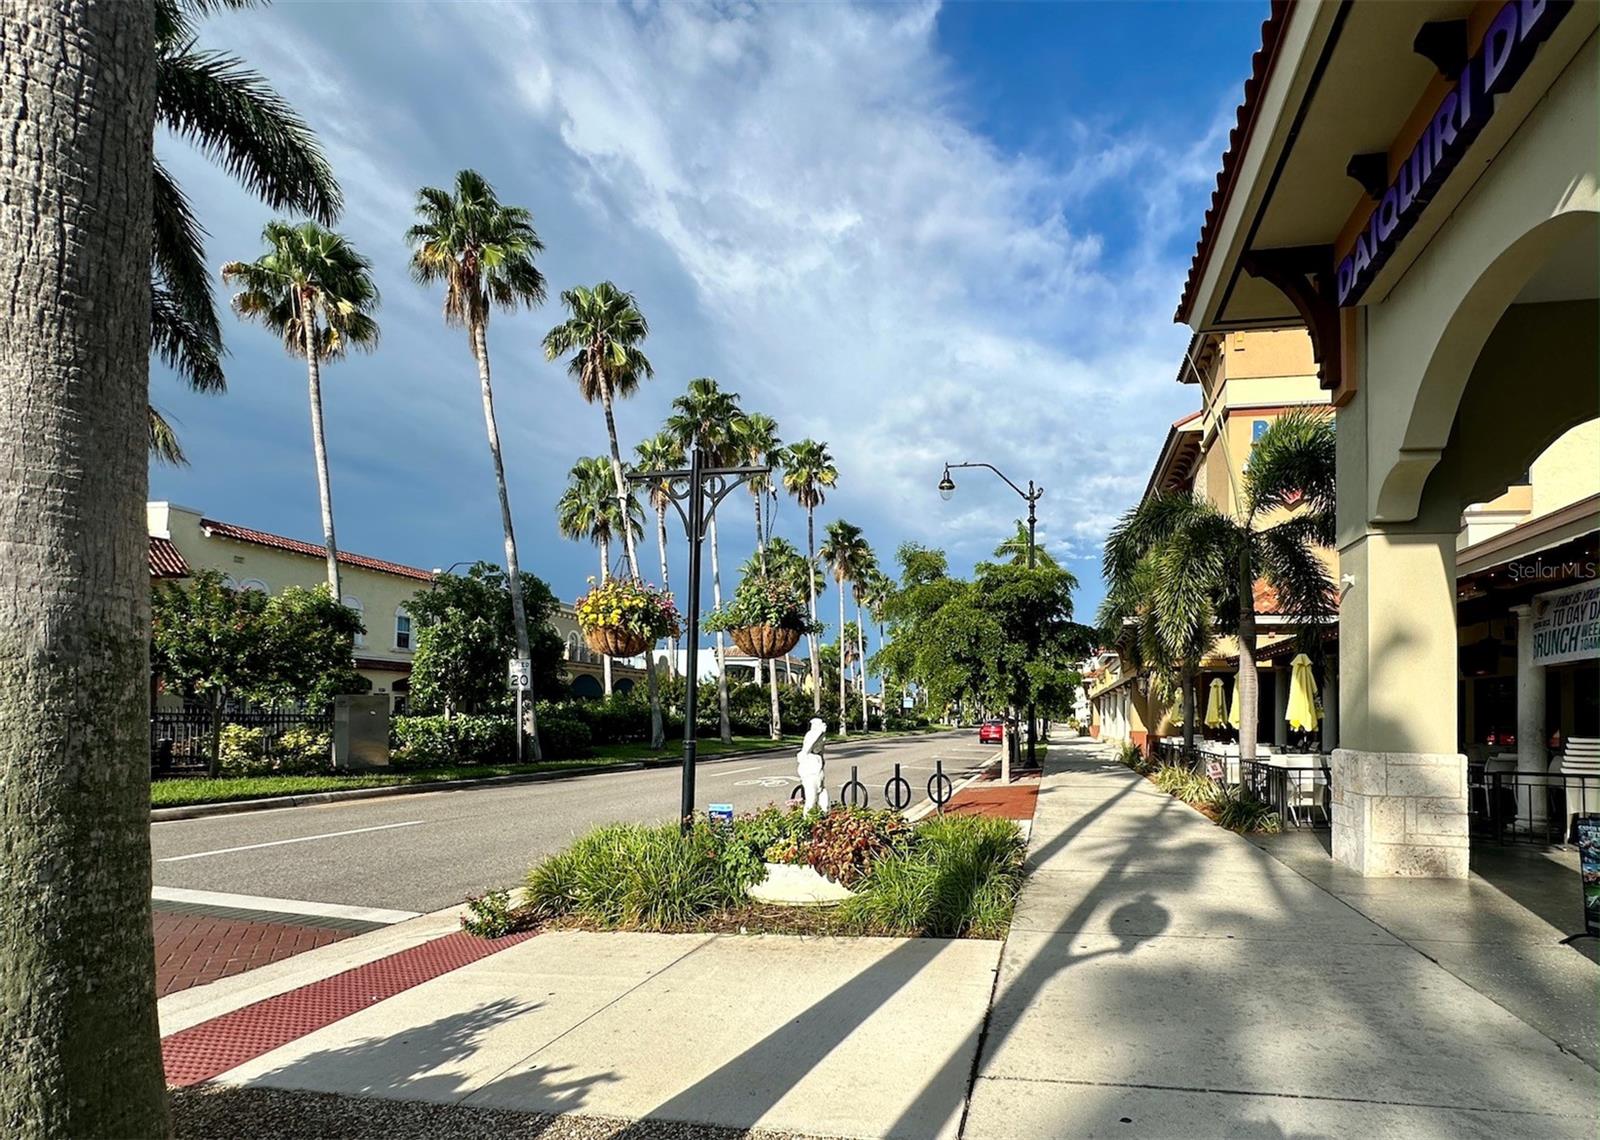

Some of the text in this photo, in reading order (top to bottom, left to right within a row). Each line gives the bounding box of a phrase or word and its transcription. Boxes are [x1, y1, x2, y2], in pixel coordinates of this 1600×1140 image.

[1338, 64, 1471, 307] DAIQUIRI
[1553, 609, 1565, 627] TO
[1589, 601, 1600, 621] D
[1581, 622, 1600, 637] WEE
[511, 674, 529, 686] 20
